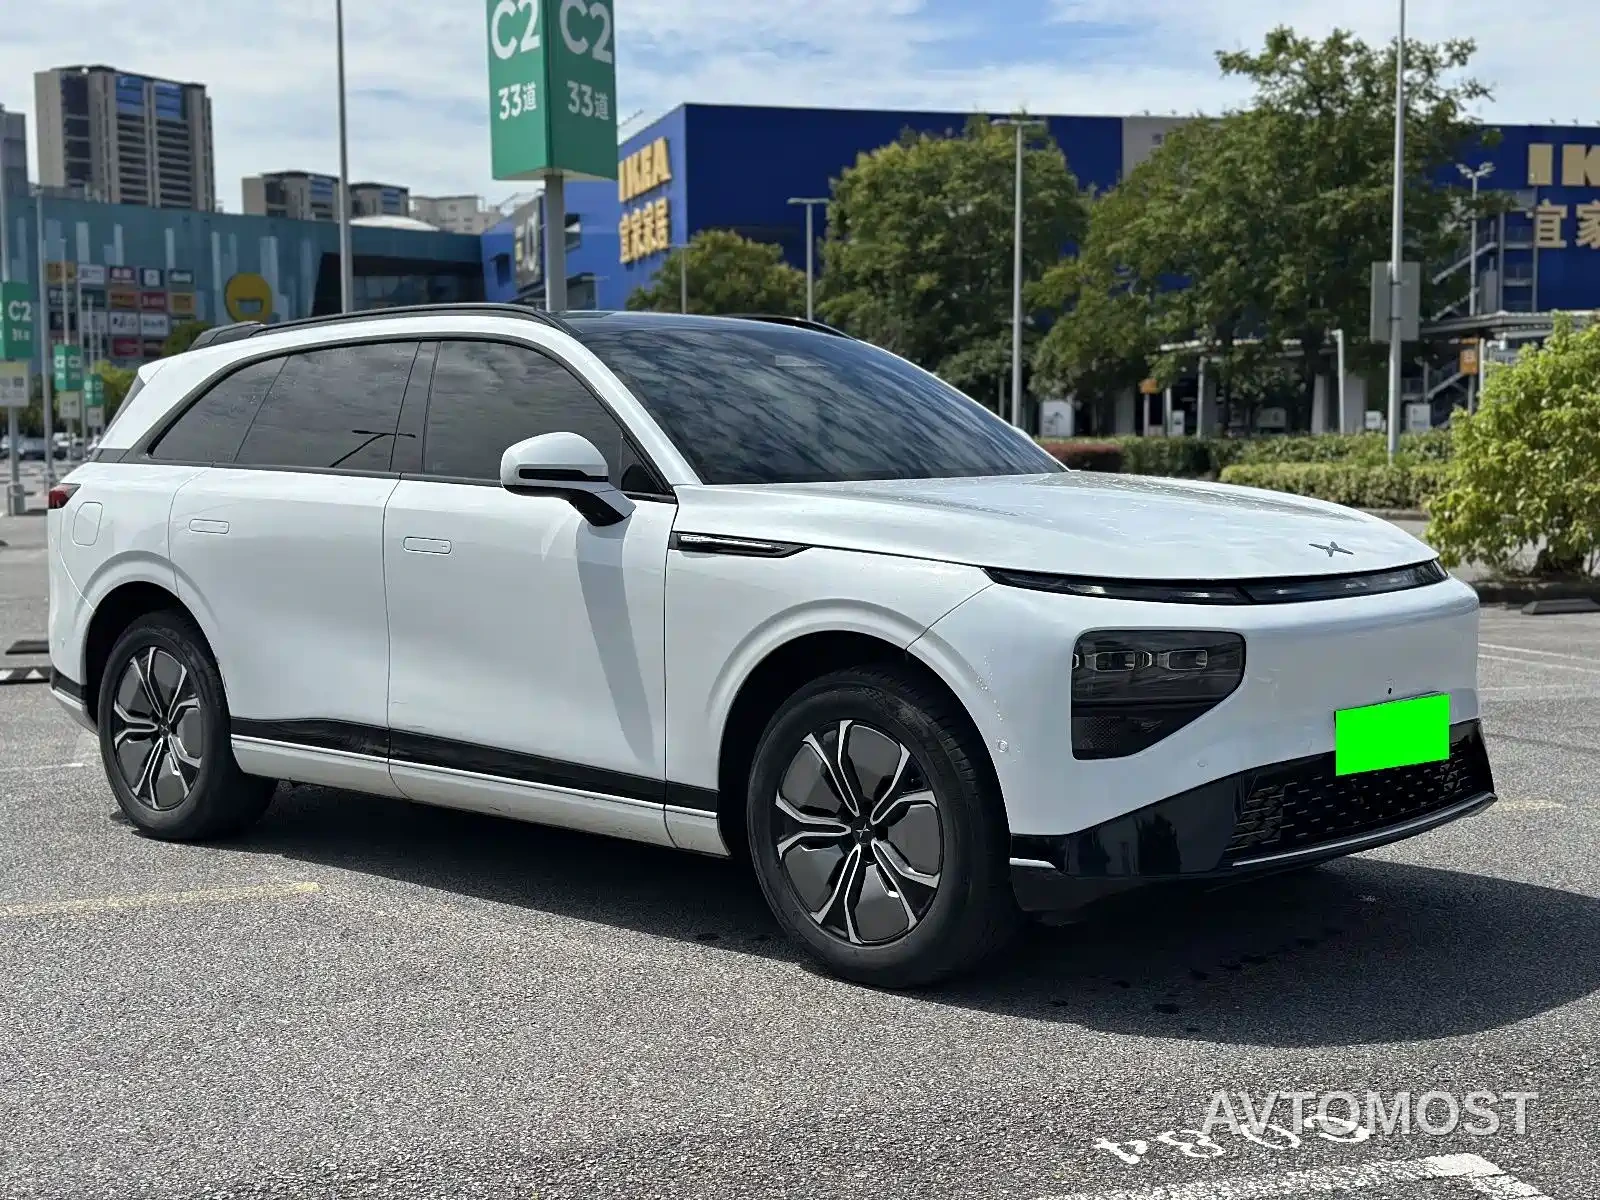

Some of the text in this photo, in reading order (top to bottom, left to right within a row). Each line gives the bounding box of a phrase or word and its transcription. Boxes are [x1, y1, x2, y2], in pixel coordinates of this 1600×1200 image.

[491, 0, 541, 60] C2
[559, 0, 613, 65] C2
[498, 81, 537, 120] 33道
[567, 80, 610, 121] 33道
[618, 136, 672, 203] IKEA
[8, 300, 33, 322] C2
